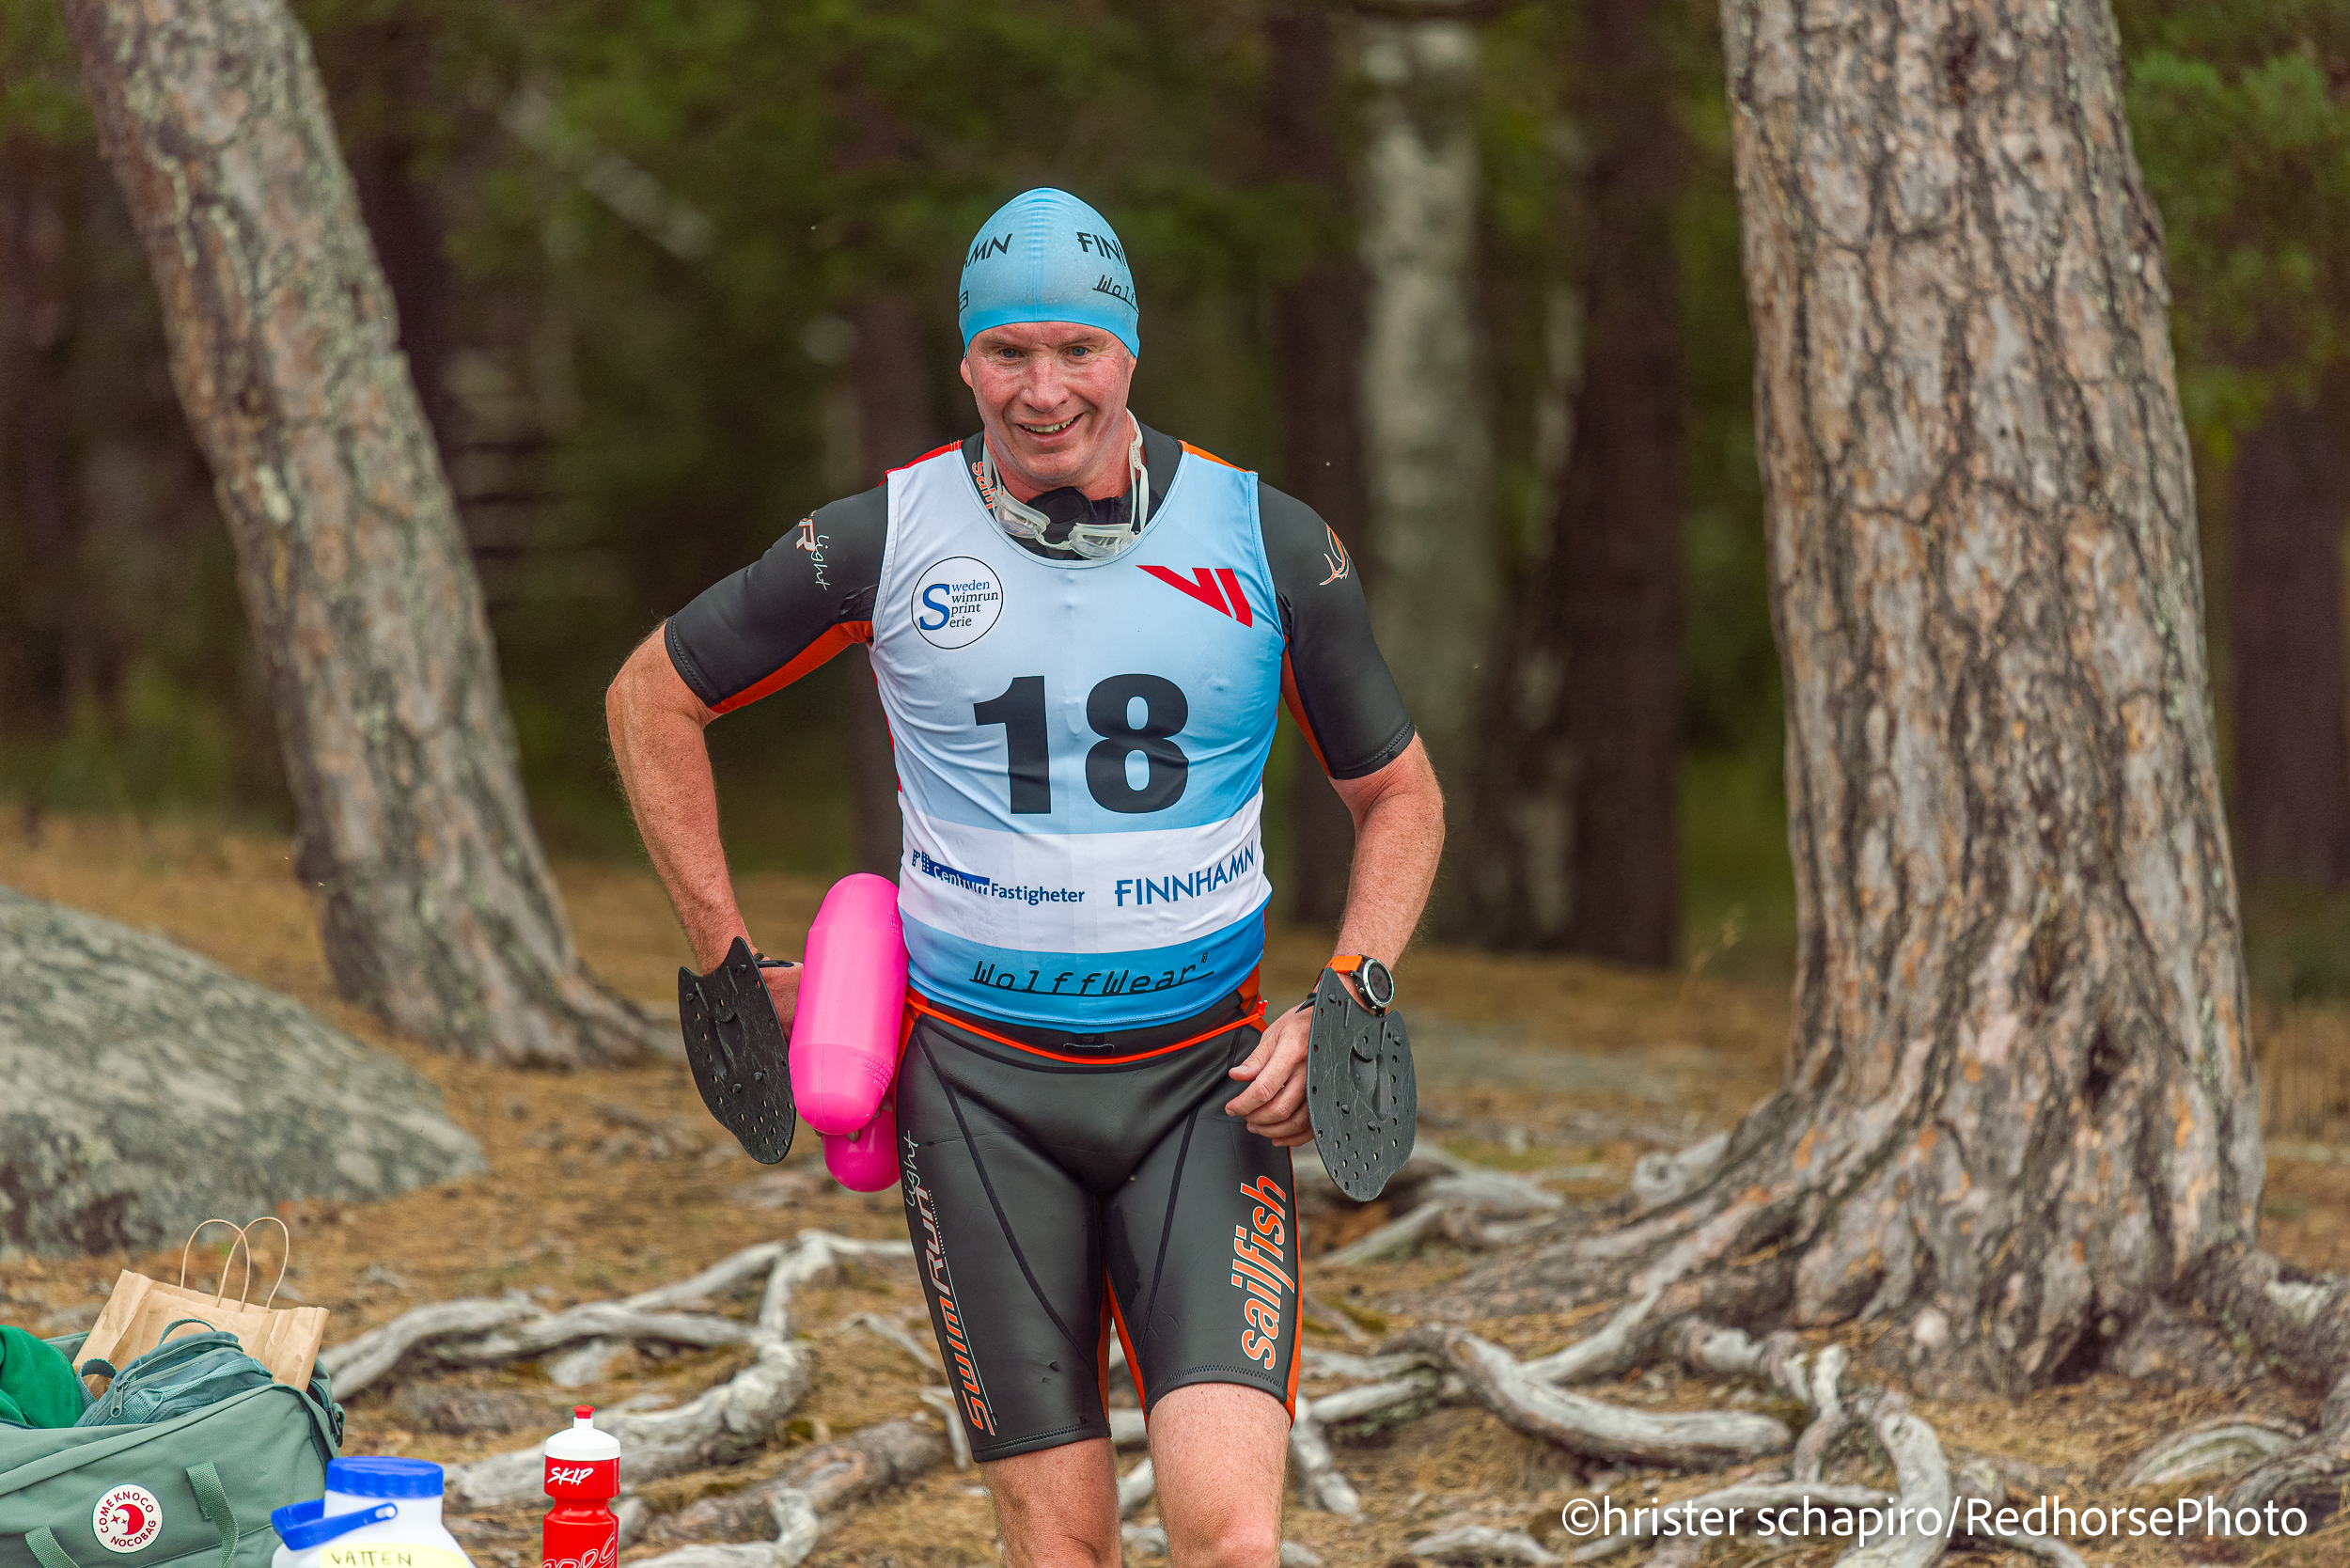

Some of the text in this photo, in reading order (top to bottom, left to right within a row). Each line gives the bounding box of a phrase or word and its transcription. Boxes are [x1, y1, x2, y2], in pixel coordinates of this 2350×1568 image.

[973, 673, 1189, 814] 18
[1115, 839, 1254, 907] FINNHAMN
[1230, 1175, 1295, 1371] sailfish
[547, 1466, 594, 1485] SKIP
[99, 1491, 154, 1533] COME KNOCO
[111, 1520, 157, 1547] NOCOBAG
[330, 1551, 412, 1567] VATTEN
